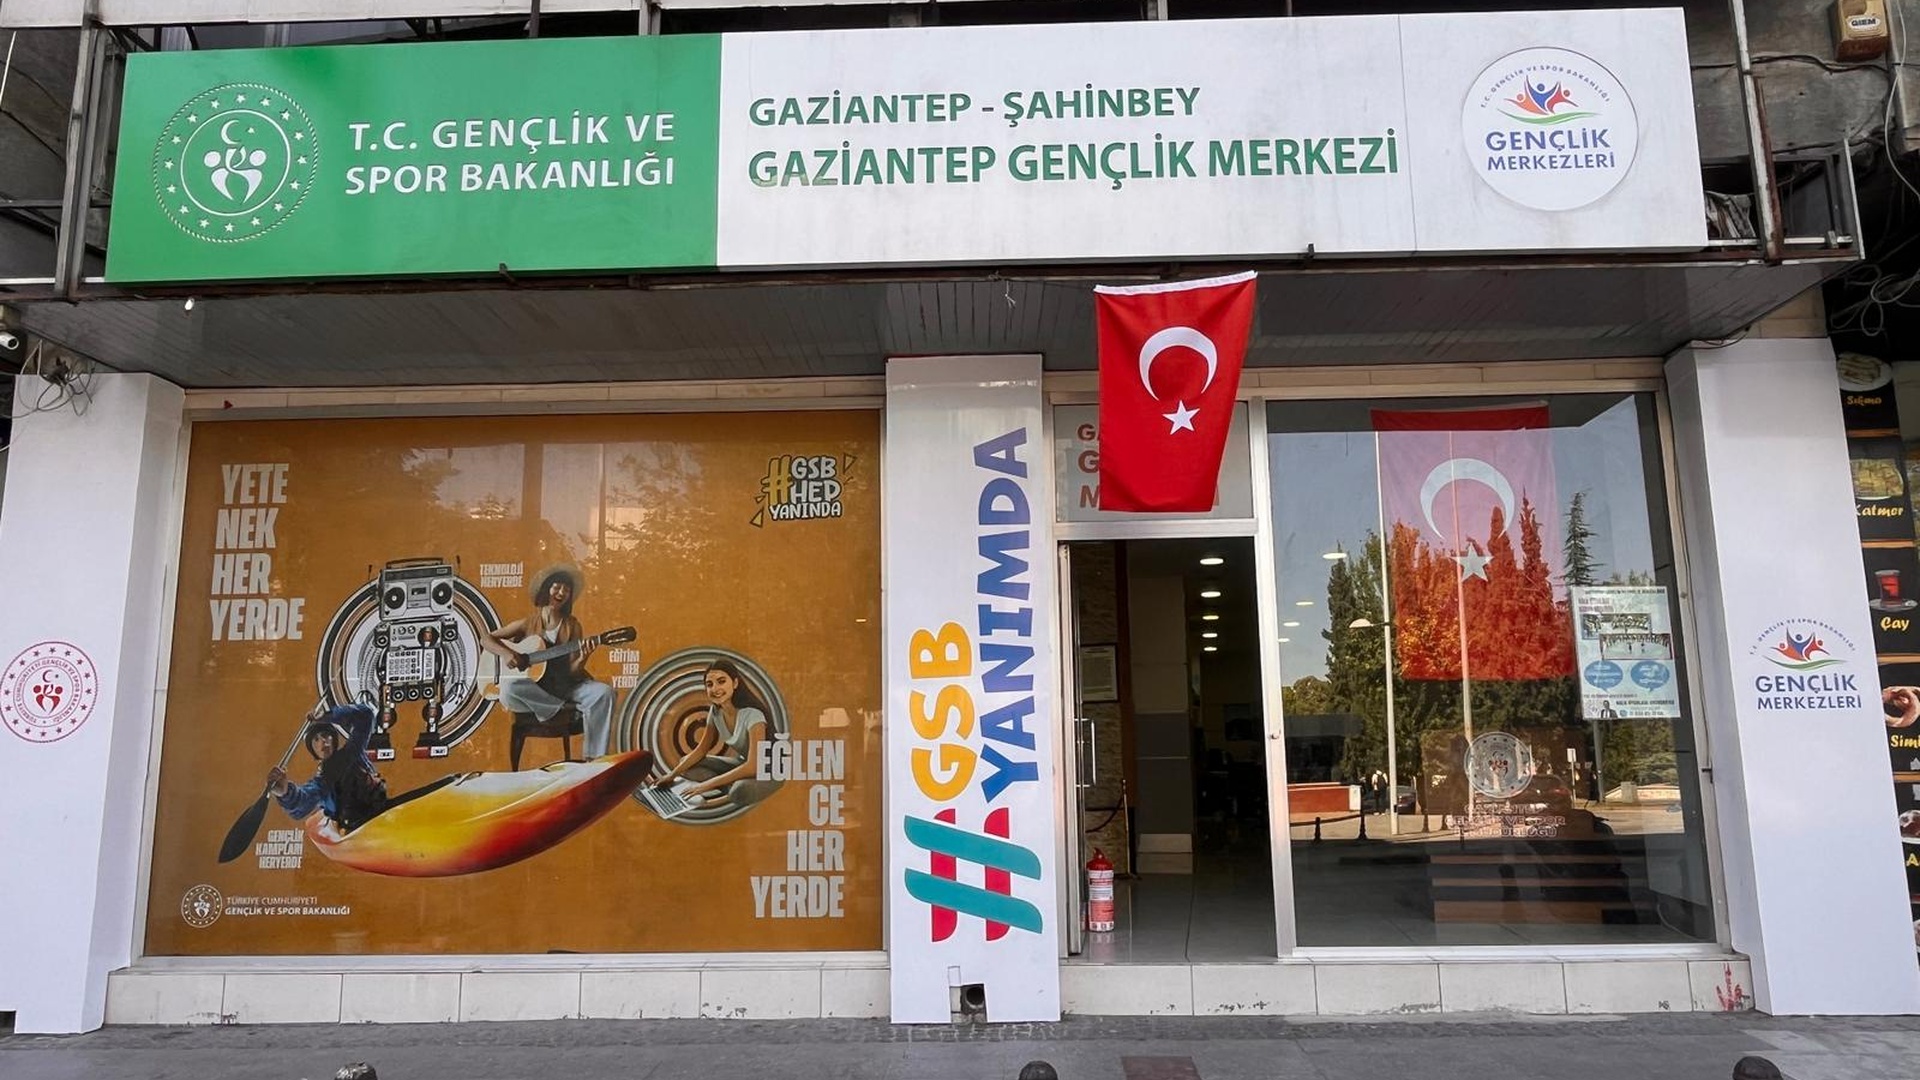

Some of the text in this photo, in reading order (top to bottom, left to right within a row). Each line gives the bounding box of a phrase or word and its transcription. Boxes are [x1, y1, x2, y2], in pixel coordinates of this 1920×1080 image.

[748, 89, 971, 126] GAZİANTEP
[1003, 84, 1201, 128] ŞAHİNBEY
[348, 110, 675, 153] T.C. GENÇLİK VE
[1486, 128, 1611, 152] GENÇLİK
[345, 151, 674, 195] SPOR BAKANLIĞI
[747, 127, 1399, 190] GAZİANTEP GENÇLİK MERKEZİ
[1487, 152, 1616, 170] MERKEZLERİ
[221, 463, 289, 504] YETE
[790, 480, 841, 503] HEP
[215, 508, 279, 549] NEK
[769, 502, 841, 520] YANINDA
[211, 553, 271, 595] HER
[209, 598, 305, 641] YERDE
[973, 426, 1040, 803] YANIMDA
[622, 663, 639, 675] HER
[1755, 672, 1857, 694] GENÇLİK
[908, 621, 978, 802] GSB
[1757, 695, 1862, 710] MERKEZLERİ
[756, 732, 845, 782] EĞLEN
[809, 784, 845, 827] CE
[787, 829, 845, 872] HER
[225, 904, 350, 917] GENÇLİK VE SPOR BAKANLIĞI
[750, 875, 845, 918] YERDE
